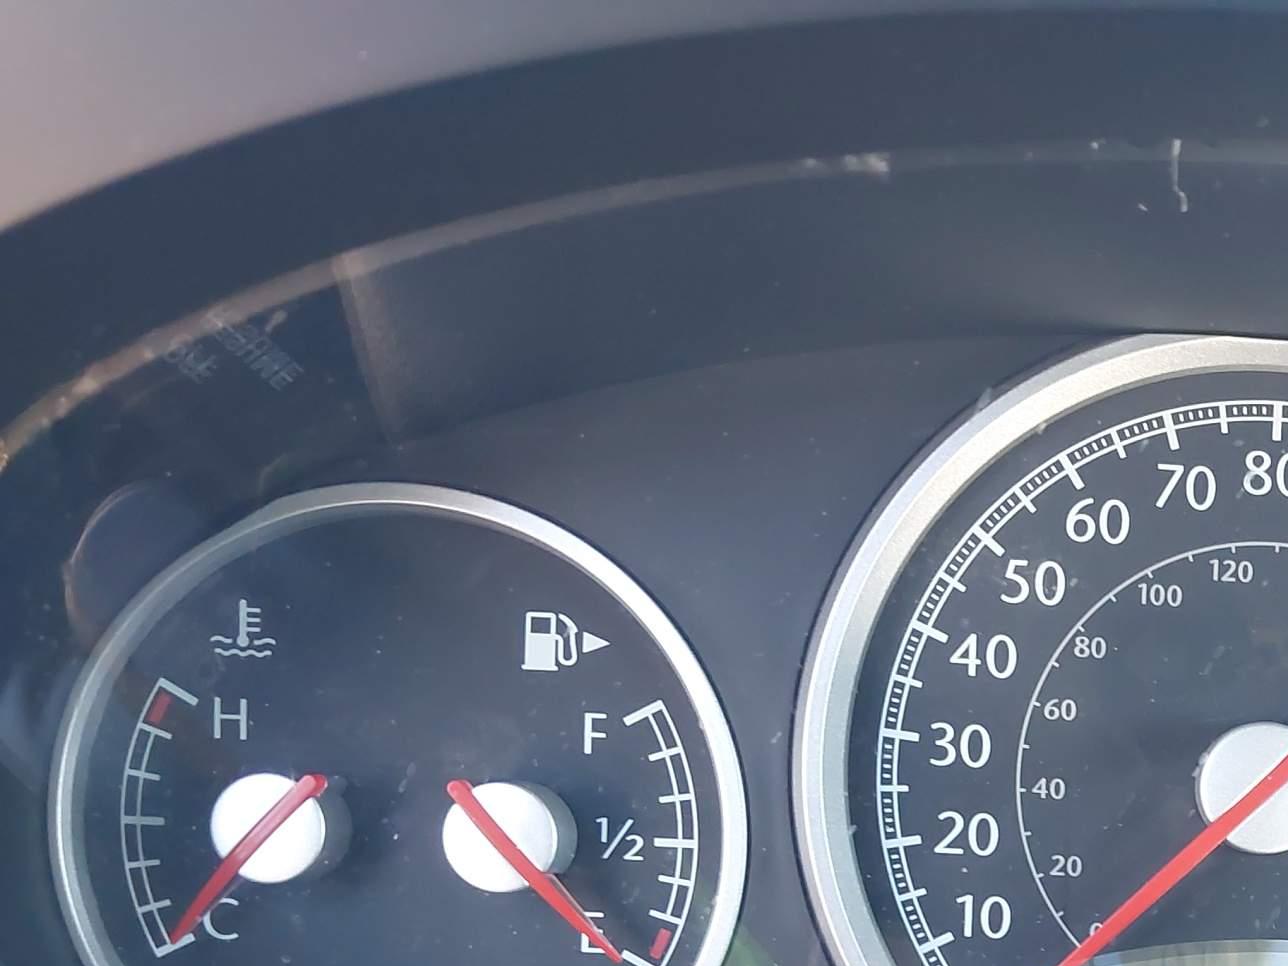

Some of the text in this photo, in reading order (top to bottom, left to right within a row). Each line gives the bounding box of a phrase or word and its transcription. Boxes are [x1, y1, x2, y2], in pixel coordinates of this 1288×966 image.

[1155, 463, 1216, 511] 70
[1066, 498, 1130, 545] 60
[1000, 559, 1066, 606] 50
[1209, 559, 1253, 583] 120
[1138, 583, 1182, 607] 100
[950, 633, 1017, 678] 40
[1073, 636, 1106, 659] 80
[213, 697, 247, 740] H
[1044, 699, 1077, 721] 60
[584, 712, 607, 753] F
[929, 723, 991, 768] 30
[1032, 778, 1065, 799] 40
[933, 811, 998, 856] 20
[1050, 855, 1082, 877] 20
[203, 899, 239, 939] C
[956, 894, 1011, 938] 10
